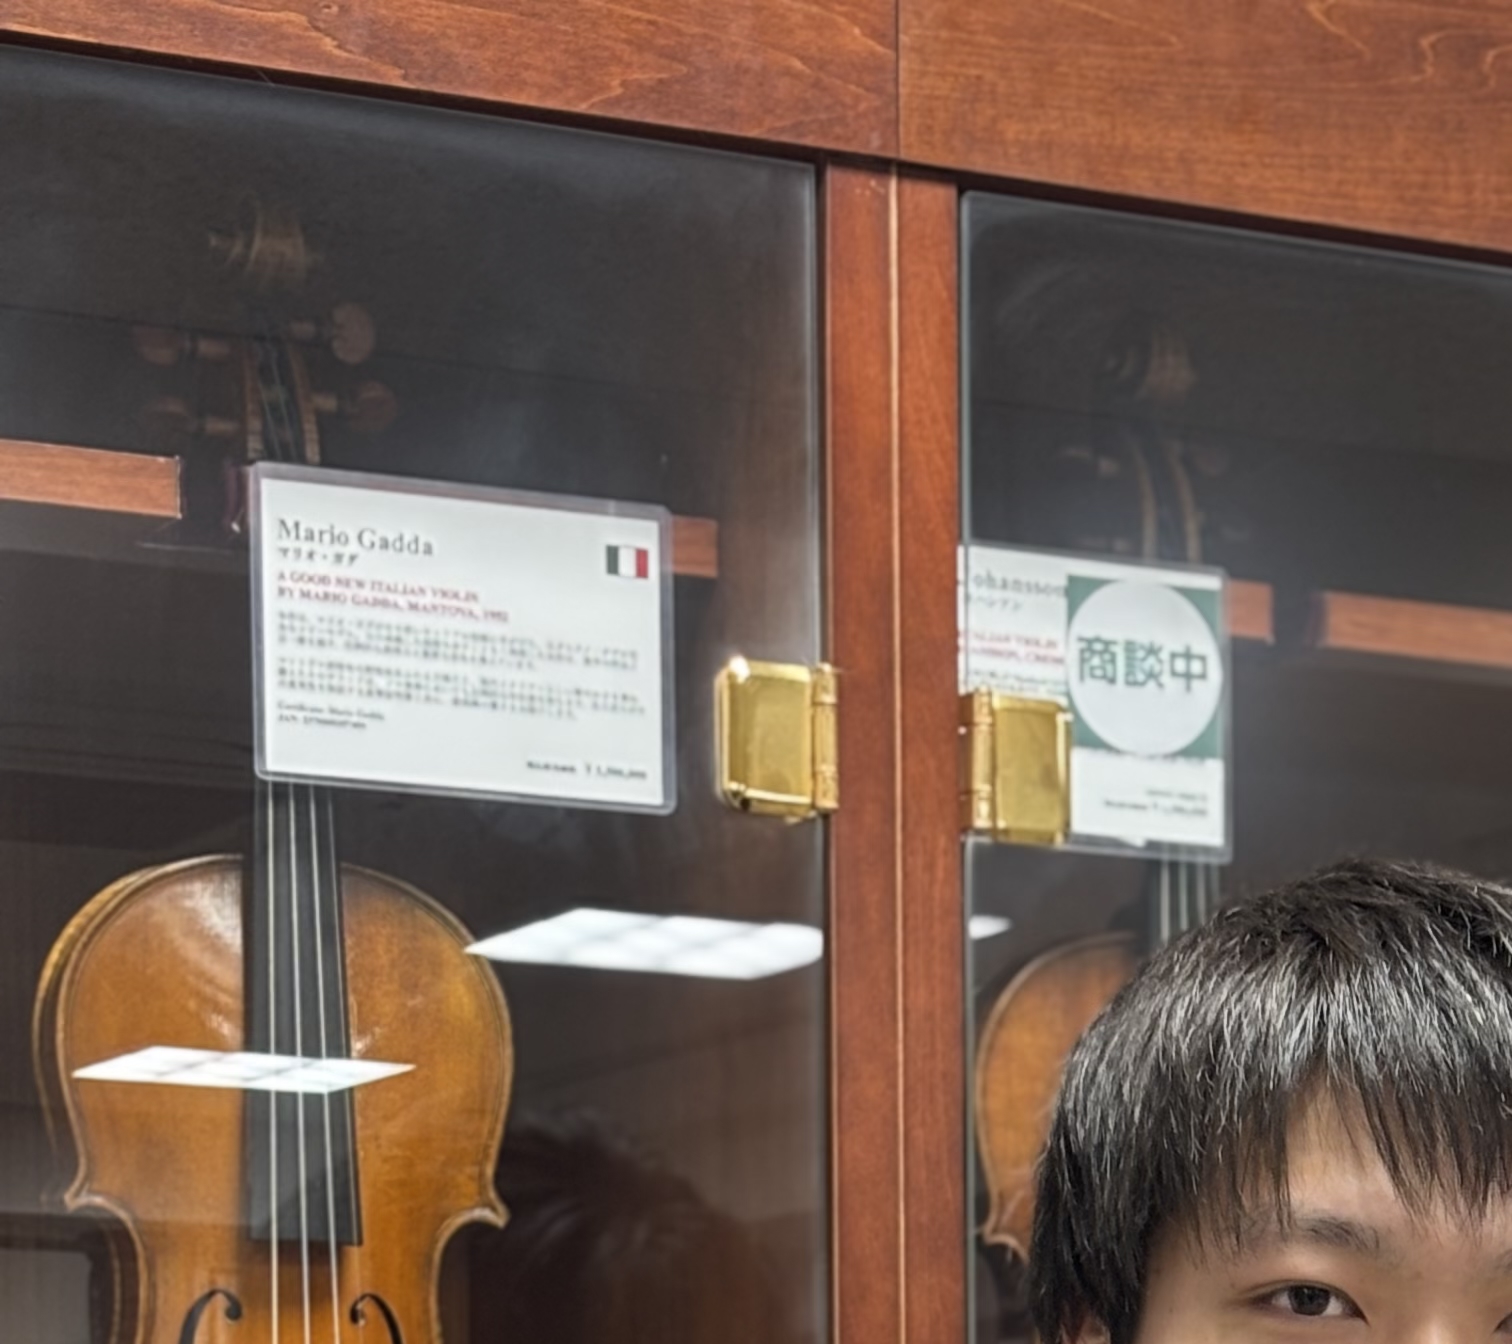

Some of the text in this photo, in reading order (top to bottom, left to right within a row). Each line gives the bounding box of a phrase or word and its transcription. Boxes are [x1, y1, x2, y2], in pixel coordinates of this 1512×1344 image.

[278, 518, 434, 556] Mario Gadda
[1077, 636, 1207, 692] 商談中
